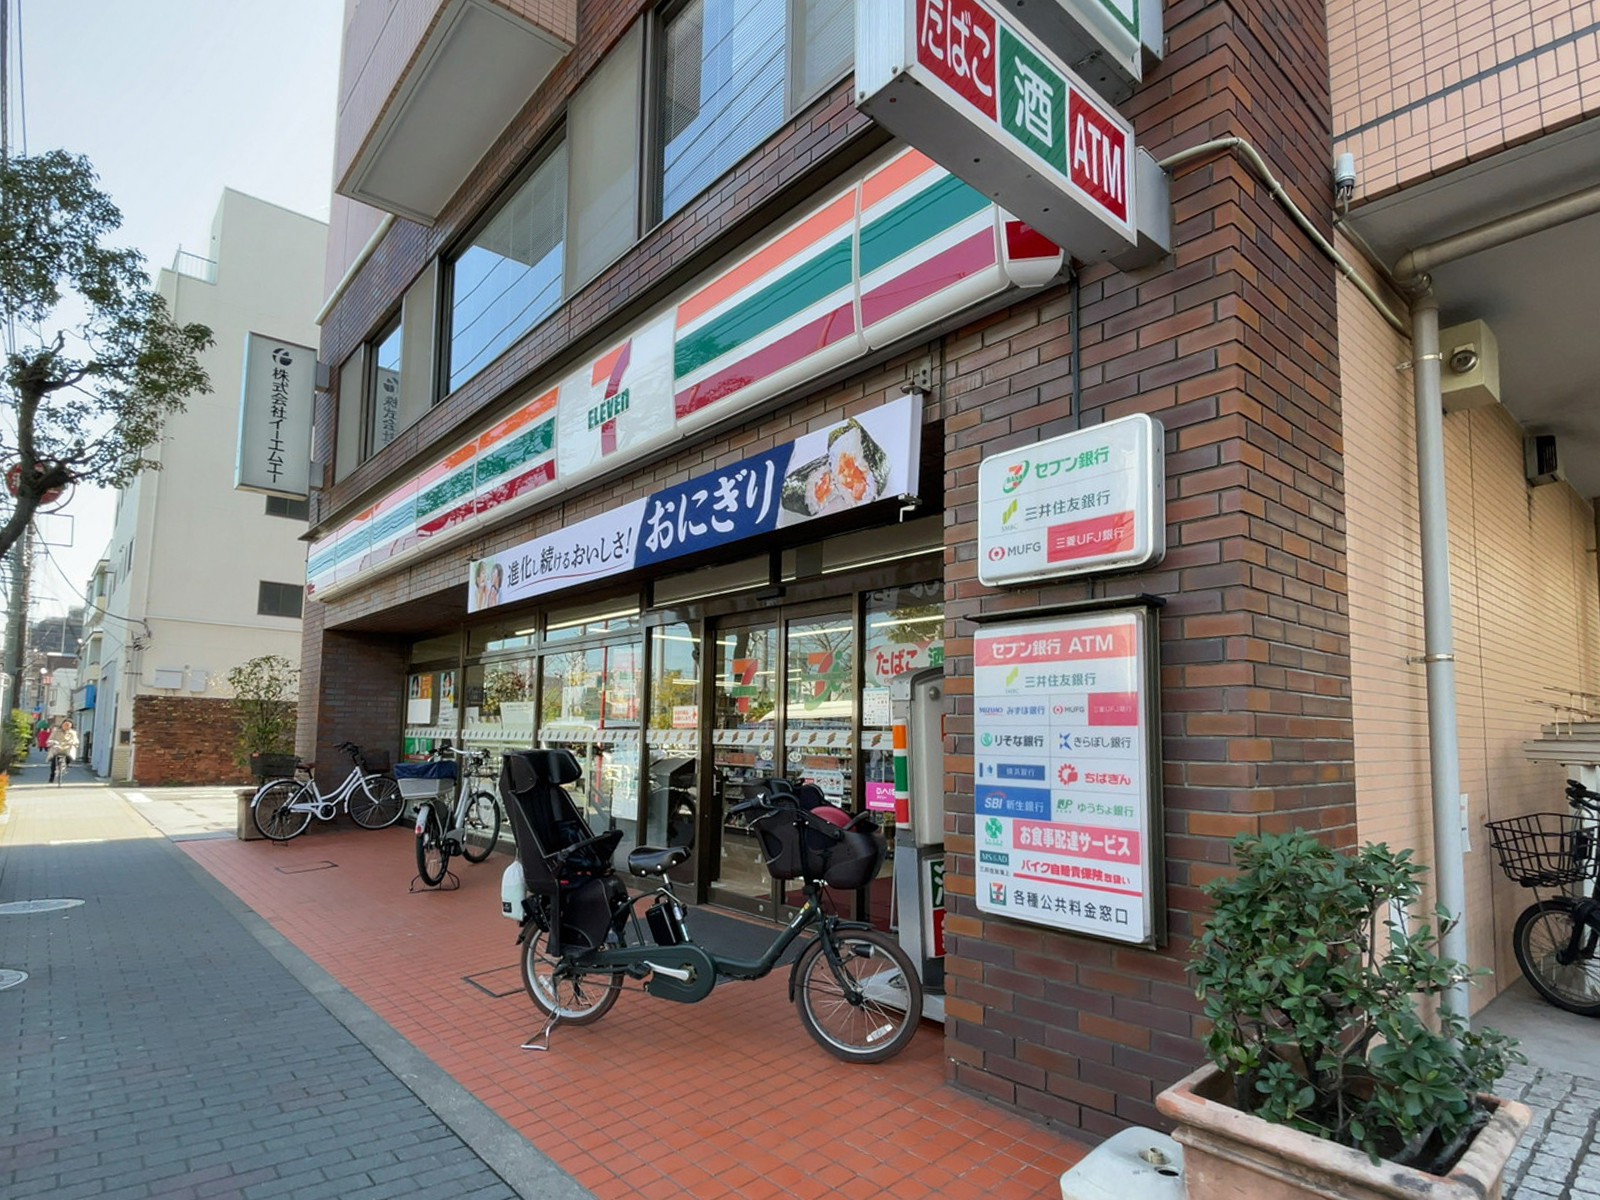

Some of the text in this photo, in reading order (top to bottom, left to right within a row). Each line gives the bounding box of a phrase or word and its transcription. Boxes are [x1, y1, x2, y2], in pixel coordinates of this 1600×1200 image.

[921, 0, 992, 97] たばこ
[1014, 55, 1054, 148] 酒
[1073, 113, 1122, 204] ATM
[267, 367, 290, 483] 株式会社イーエムエー
[1034, 446, 1109, 480] セブン銀行
[644, 460, 775, 553] おにぎり
[1025, 490, 1111, 521] 三井住友銀行
[1007, 542, 1041, 557] MUFG
[1055, 528, 1124, 549] 三菱UFJ銀行
[992, 634, 1113, 660] セブン銀行 ATM
[876, 648, 918, 676] たばこ
[1025, 672, 1096, 689] 三井住友銀行
[1006, 706, 1045, 716] みずほ銀行
[994, 734, 1044, 747] りそな銀行
[1073, 736, 1131, 749] きらぼし銀行
[876, 787, 896, 796] DAIS
[1084, 772, 1131, 786] ちばぎん
[984, 797, 1044, 813] SBI 新生銀行
[1077, 803, 1134, 817] ゆうちょ銀行
[1020, 826, 1131, 857] お食事配達サービス
[1021, 859, 1130, 885] バイク自賠責保険取扱い
[1013, 890, 1128, 925] 各種公共料金窓口
